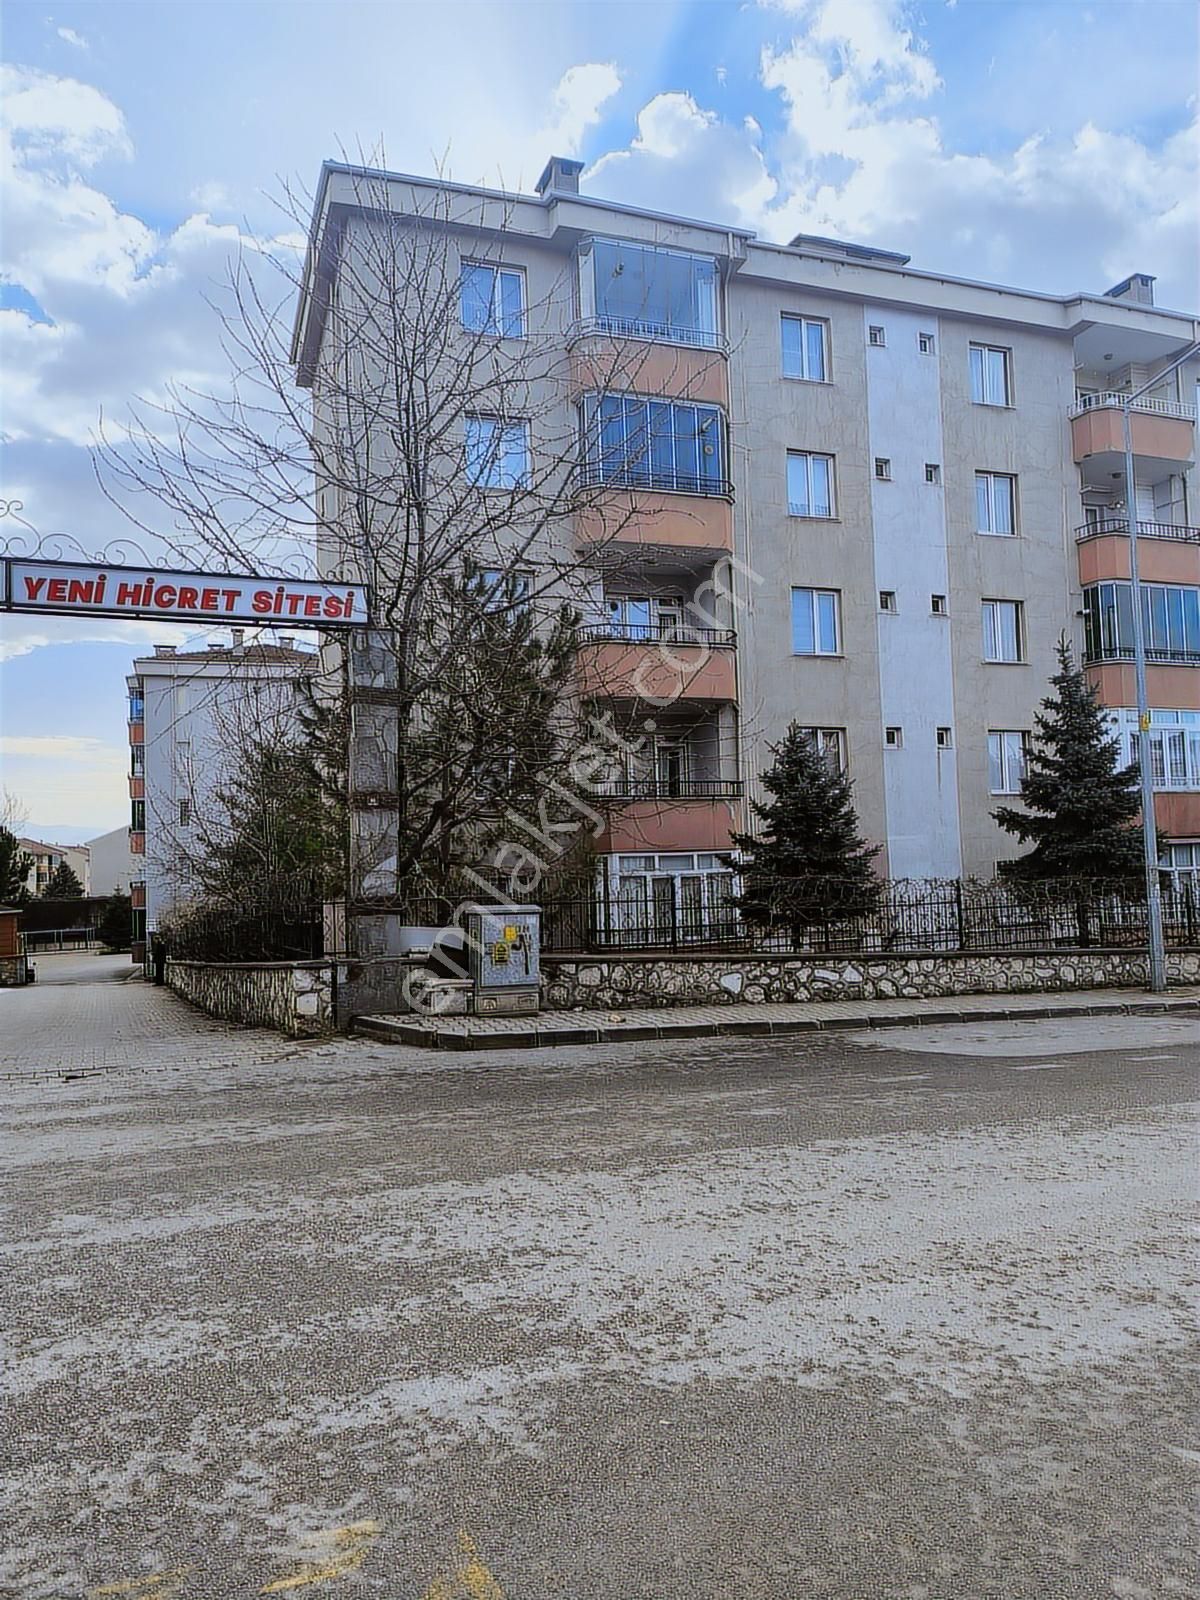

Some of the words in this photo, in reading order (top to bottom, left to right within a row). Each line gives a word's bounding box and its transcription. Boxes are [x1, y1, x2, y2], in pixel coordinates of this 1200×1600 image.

[24, 574, 107, 603] YENİ
[117, 578, 241, 611] HİCRET
[252, 587, 355, 617] SİTESİ
